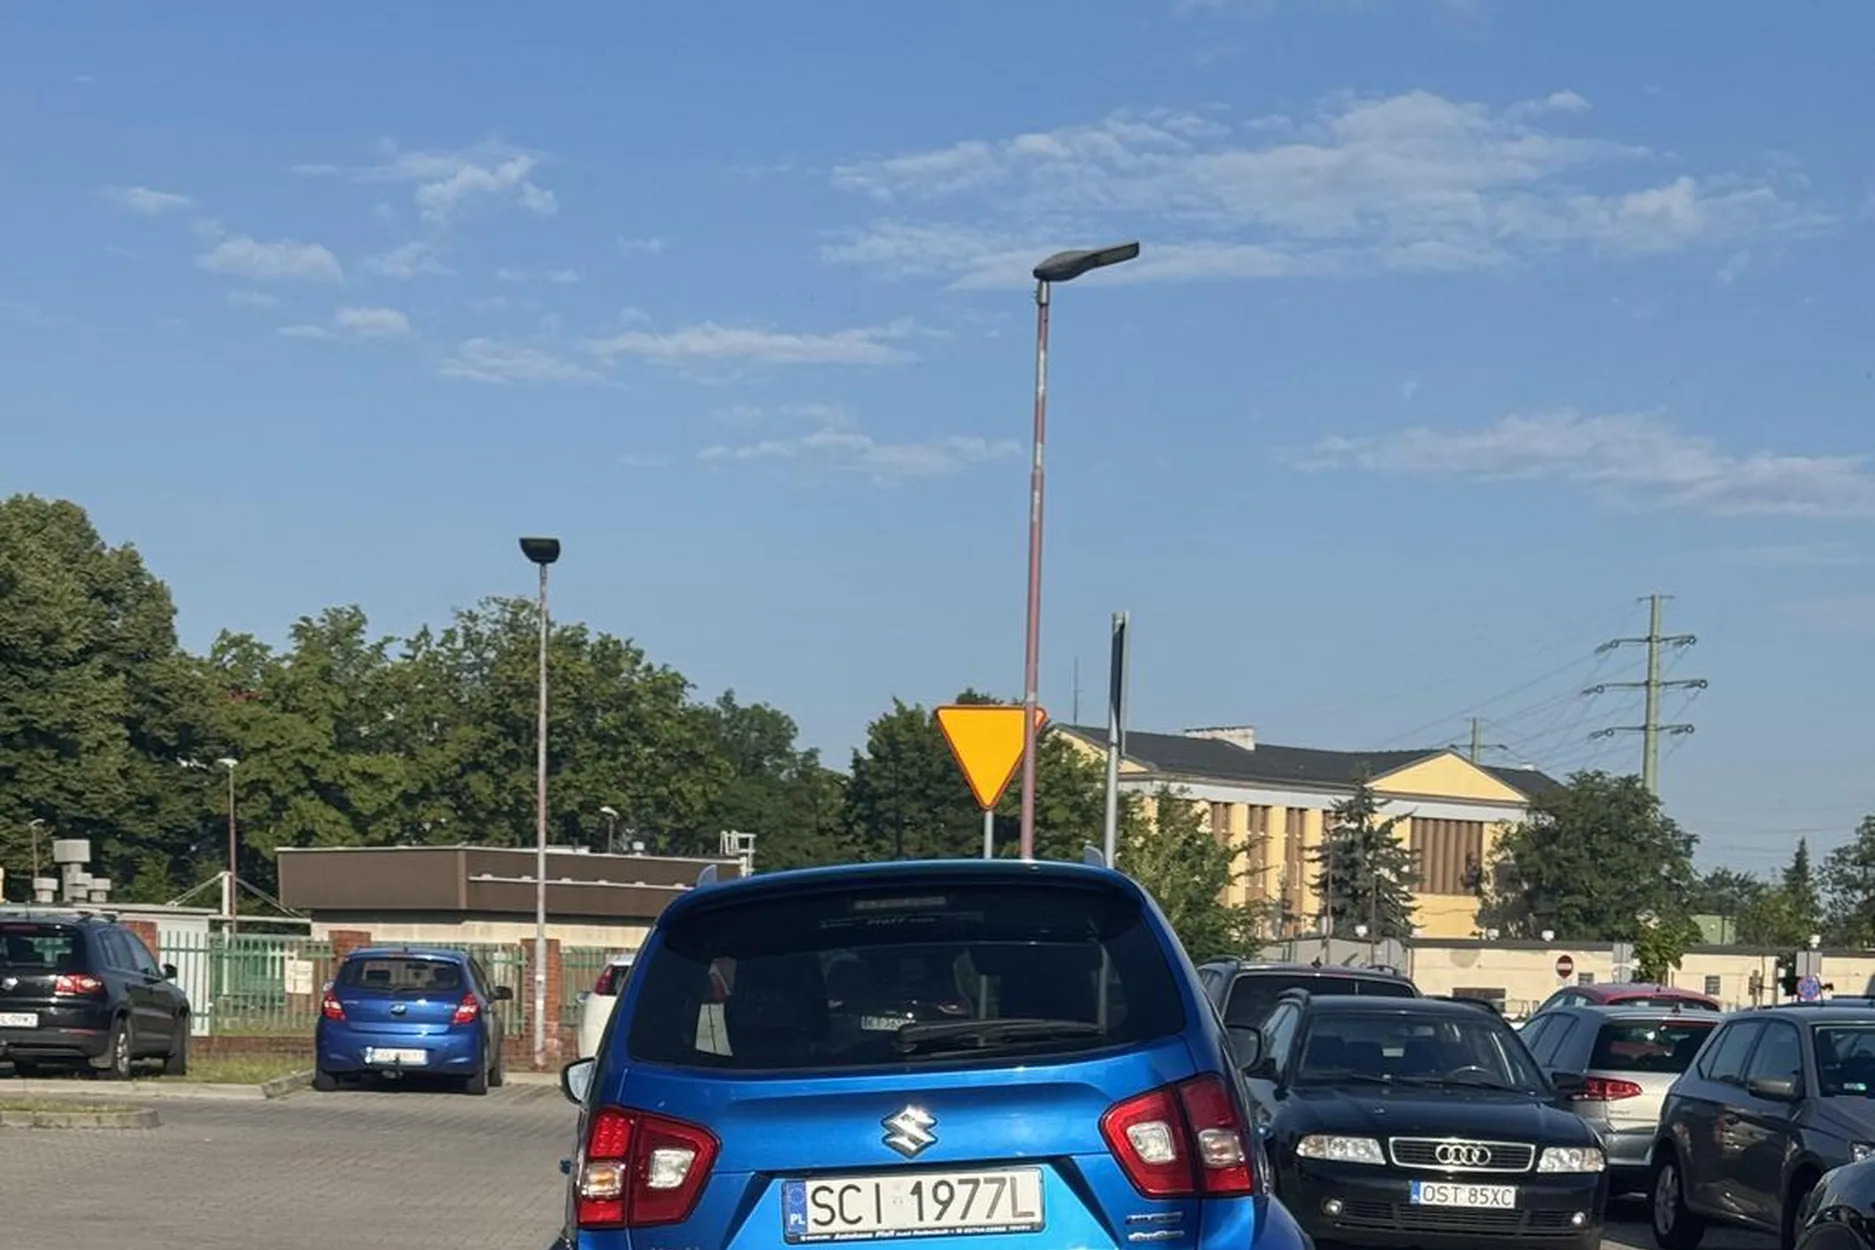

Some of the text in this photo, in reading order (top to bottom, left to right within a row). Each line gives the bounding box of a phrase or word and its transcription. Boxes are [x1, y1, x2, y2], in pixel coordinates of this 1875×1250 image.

[810, 1176, 1036, 1227] SCI 1977L
[1423, 1185, 1512, 1206] OST 85XC
[790, 1213, 806, 1225] PL
